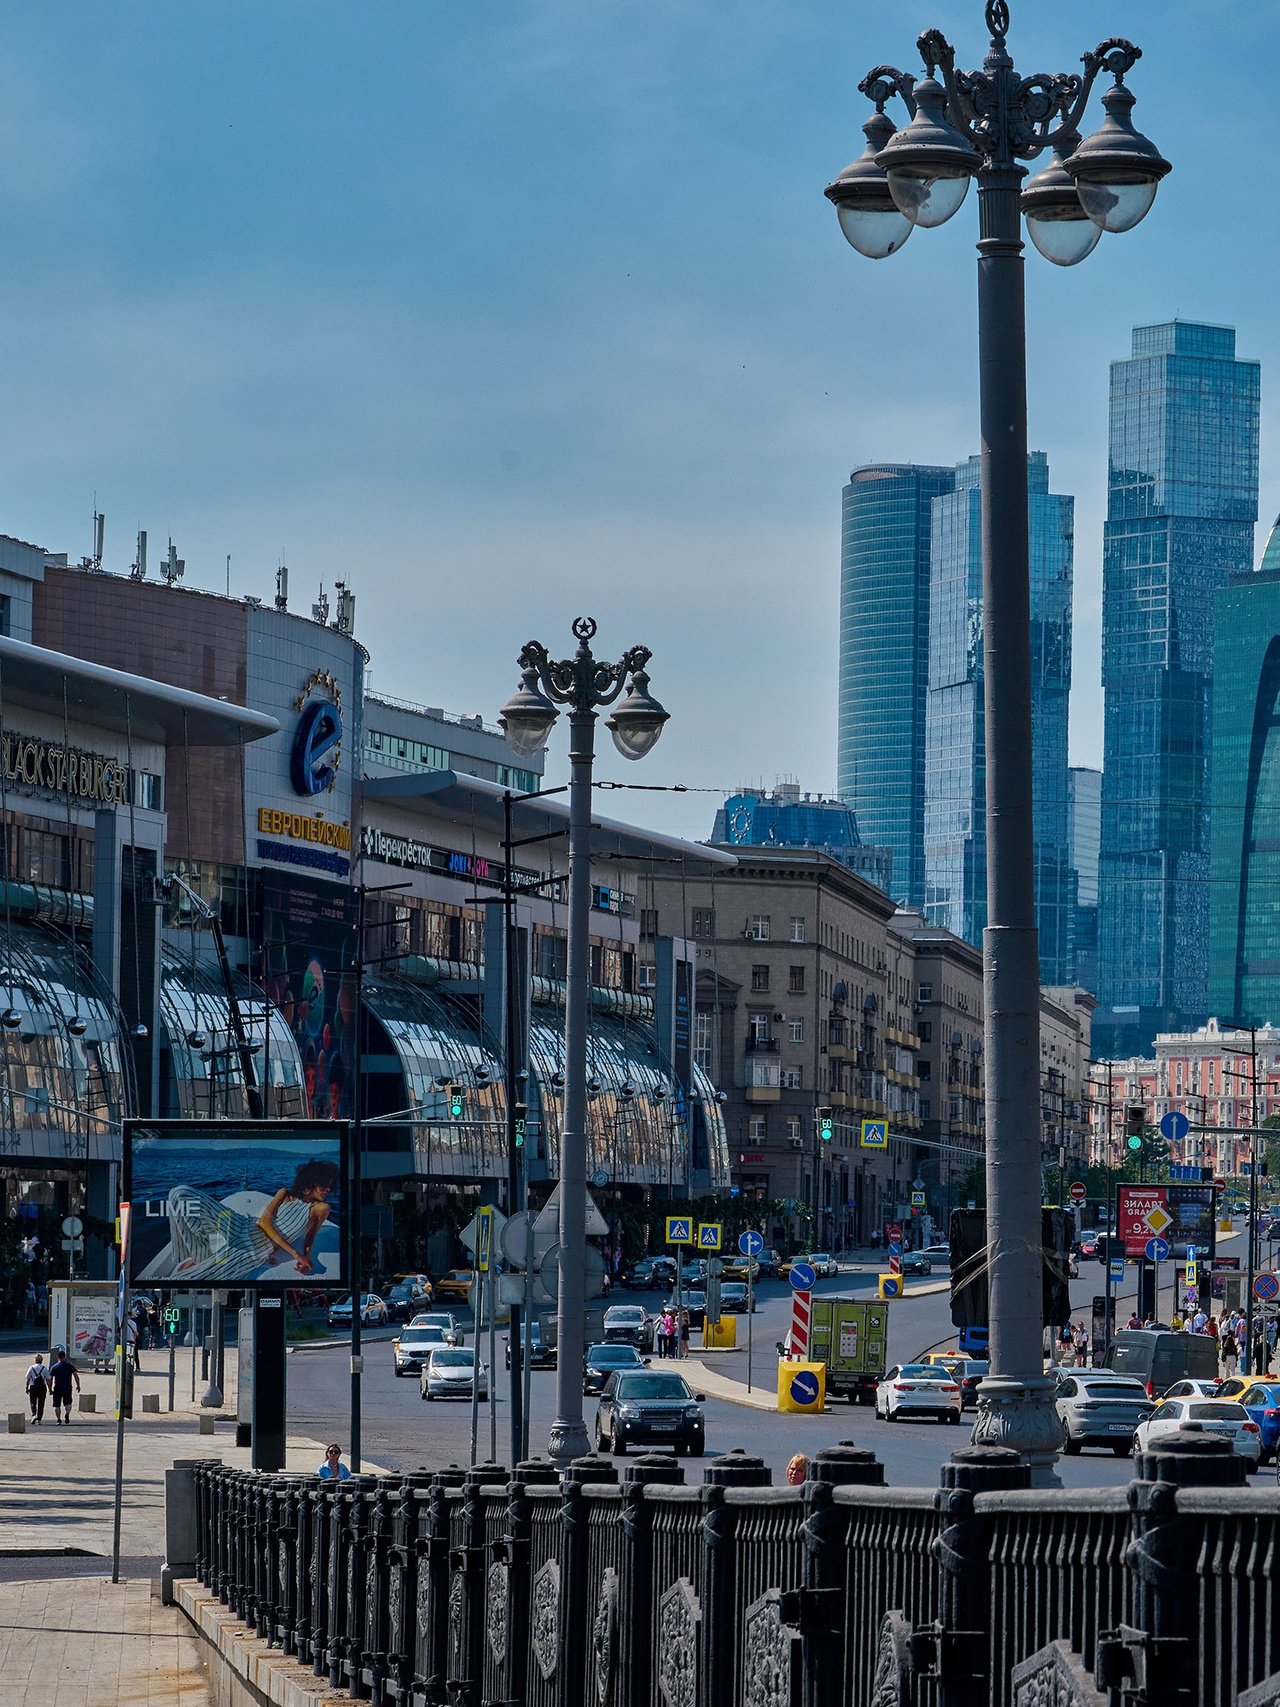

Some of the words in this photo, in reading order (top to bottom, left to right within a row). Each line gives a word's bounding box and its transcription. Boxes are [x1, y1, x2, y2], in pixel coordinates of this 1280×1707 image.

[0, 737, 45, 787] BLACK
[47, 747, 78, 795] STAR
[79, 756, 128, 806] BURGER
[258, 808, 350, 851] ЕВРОПЕЙСКИЙ
[374, 828, 432, 867] Перекрёсток
[449, 852, 467, 873] JOKI
[452, 1095, 462, 1105] 60
[822, 1119, 832, 1129] 60
[145, 1200, 201, 1218] LIME
[1127, 1208, 1151, 1217] GRAN
[164, 1308, 180, 1322] 60
